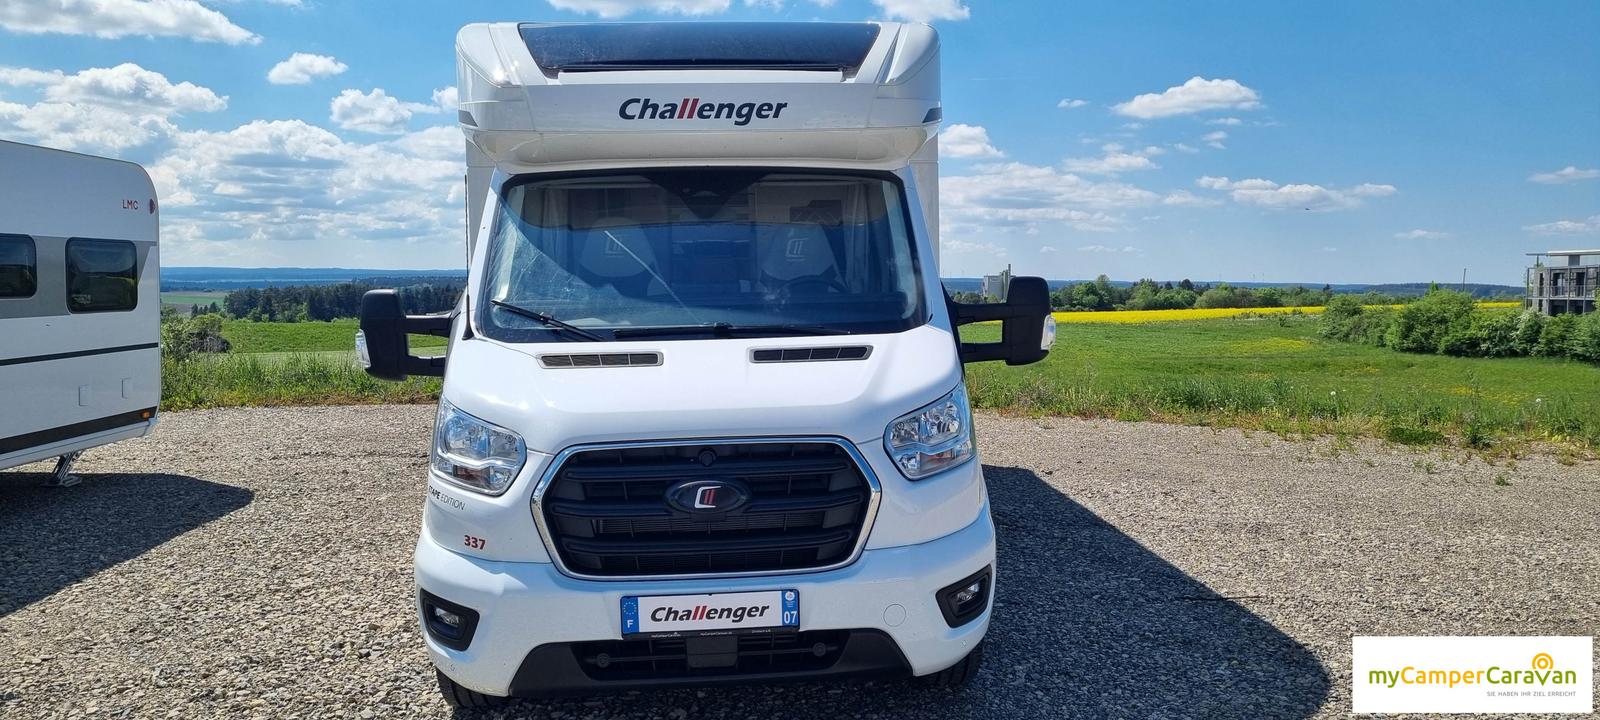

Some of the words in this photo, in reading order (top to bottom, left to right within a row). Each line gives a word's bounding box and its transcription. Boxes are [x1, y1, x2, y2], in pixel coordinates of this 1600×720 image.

[618, 98, 788, 126] Challenger
[122, 199, 139, 210] LMC
[441, 493, 466, 511] EDITION
[464, 534, 486, 550] 337
[650, 604, 770, 624] Challenger
[783, 610, 798, 624] 07
[627, 619, 634, 629] F
